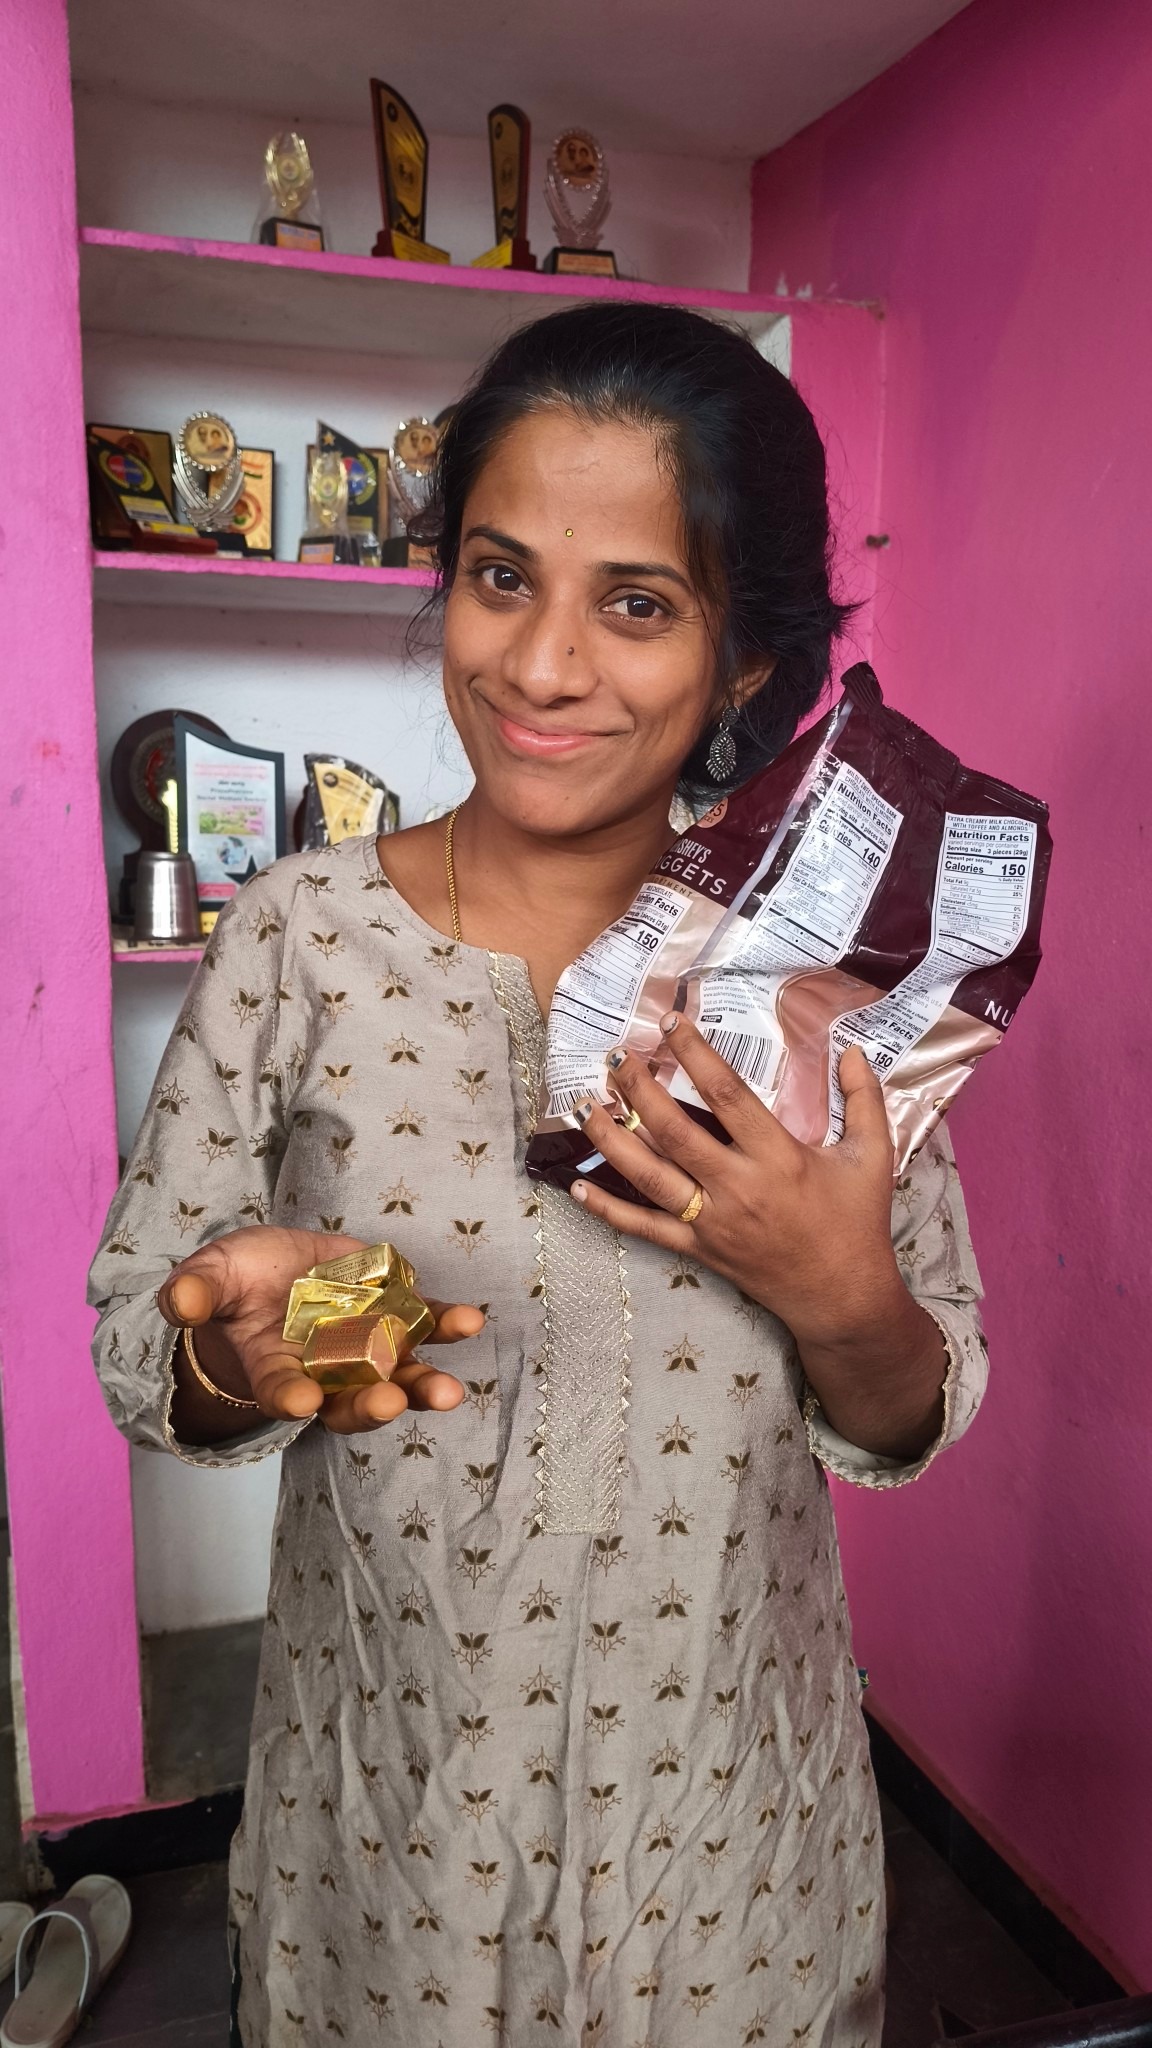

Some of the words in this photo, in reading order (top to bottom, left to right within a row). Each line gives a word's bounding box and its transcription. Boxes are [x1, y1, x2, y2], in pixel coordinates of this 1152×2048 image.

[838, 784, 872, 816] Nutrition
[872, 813, 892, 836] Facts
[863, 825, 878, 840] pieces
[1004, 820, 1034, 828] CHOCOLATE
[949, 830, 995, 841] Nutrition
[670, 838, 712, 863] SHEY'S
[863, 847, 880, 868] 140
[655, 855, 727, 895] UGGETS
[945, 861, 984, 874] Calories
[1002, 864, 1026, 876] 150
[654, 897, 678, 916] Facts
[638, 930, 658, 950] 150
[889, 1022, 914, 1040] Facts
[903, 1019, 924, 1034] ALMONDS
[875, 1052, 893, 1068] 150
